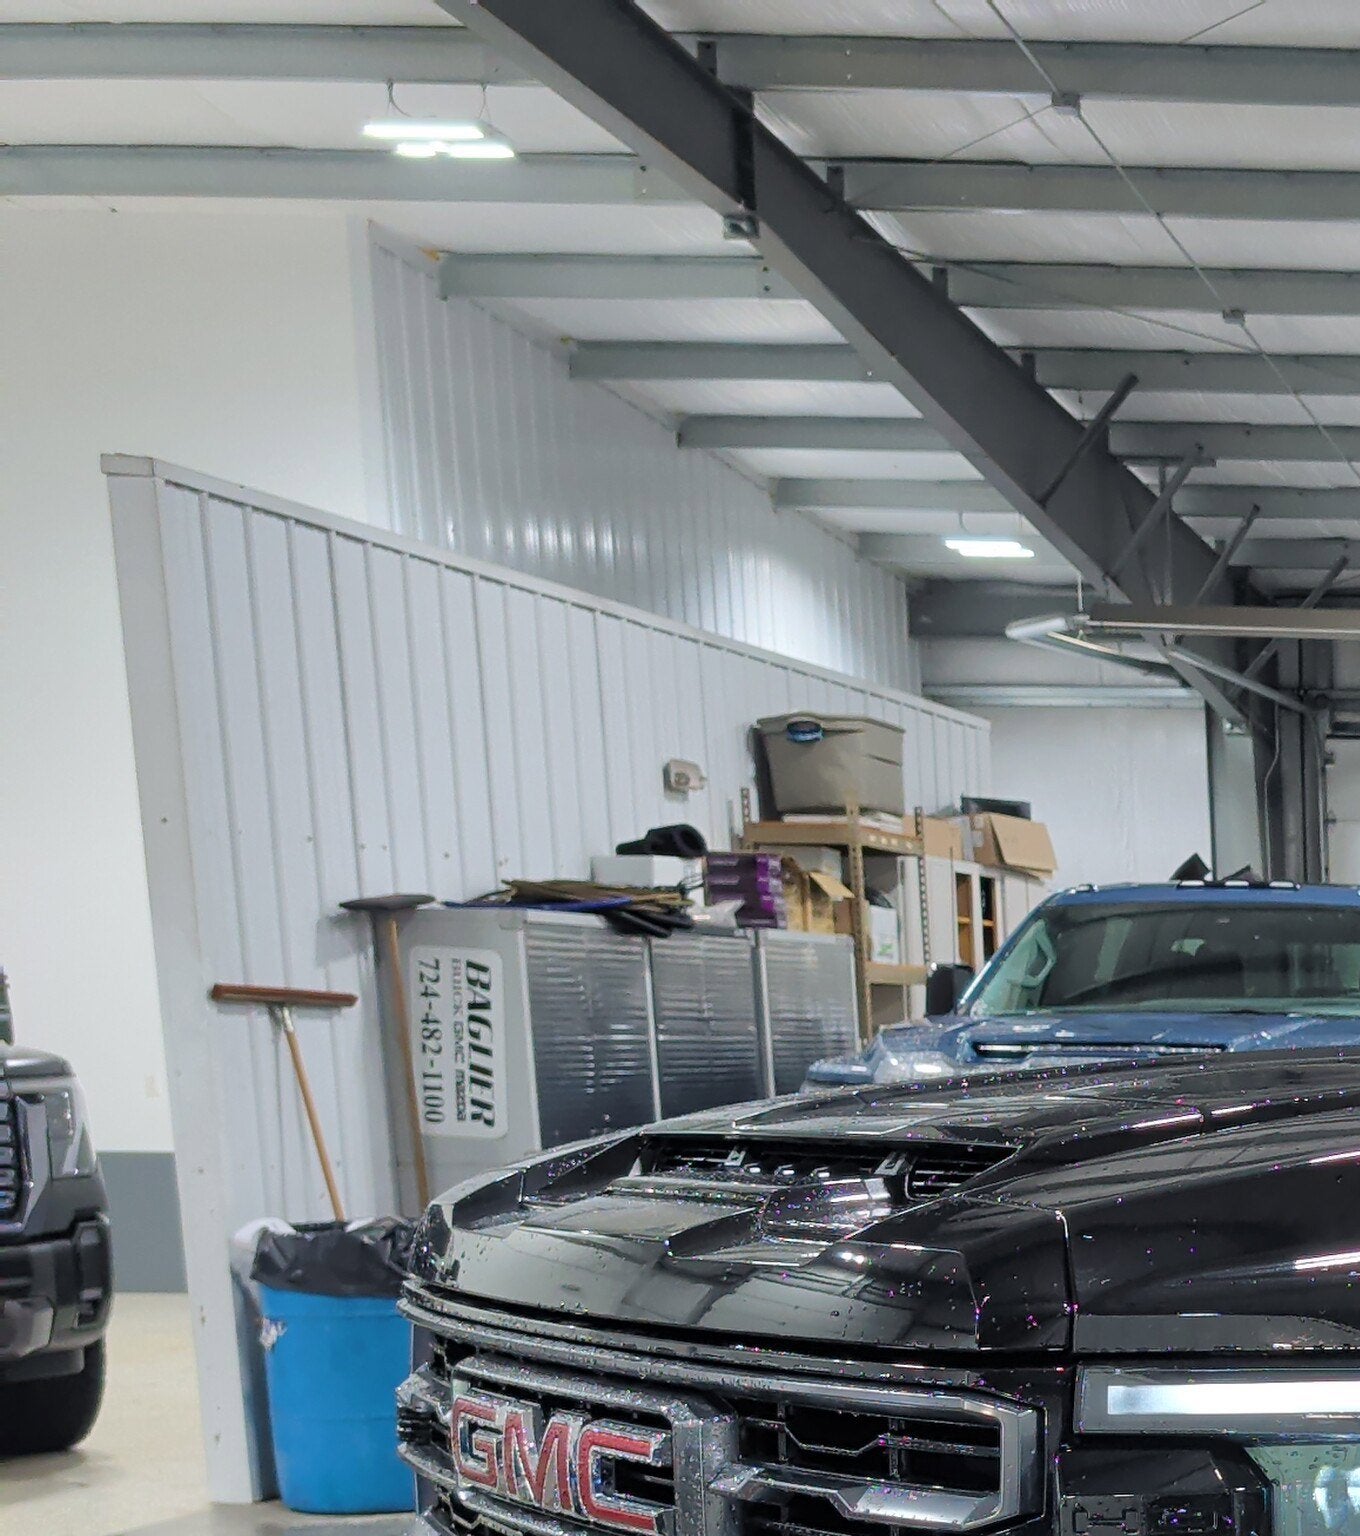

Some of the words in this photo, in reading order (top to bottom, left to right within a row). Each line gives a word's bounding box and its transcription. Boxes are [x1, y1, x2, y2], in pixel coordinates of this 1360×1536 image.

[418, 957, 446, 1124] 724-482-1100
[452, 958, 465, 1016] BUICK
[453, 1020, 465, 1063] GMC
[466, 959, 495, 1127] BAGLIER
